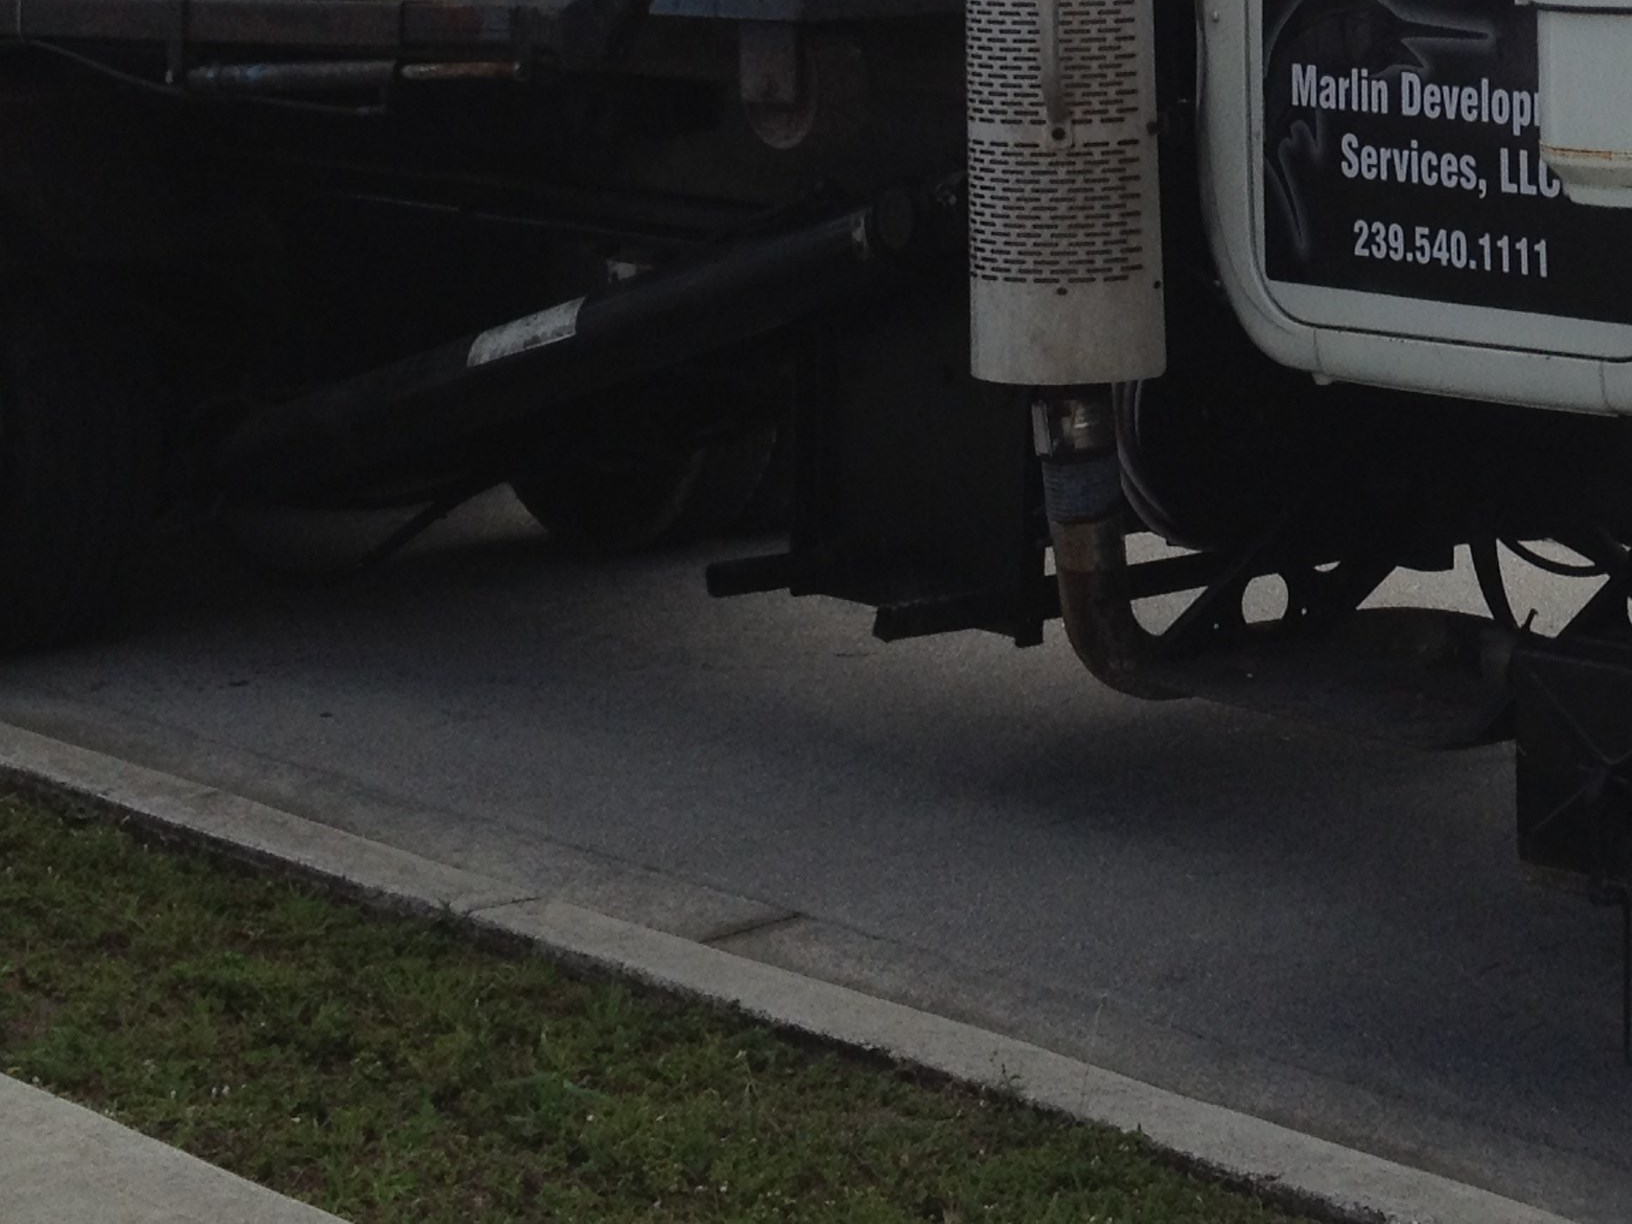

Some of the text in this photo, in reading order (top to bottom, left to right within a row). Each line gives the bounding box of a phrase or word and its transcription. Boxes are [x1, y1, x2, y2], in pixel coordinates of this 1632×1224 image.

[1290, 62, 1541, 136] Marlin Develop
[1340, 132, 1561, 199] Services, LLC
[1353, 218, 1549, 277] 239.540.1111
